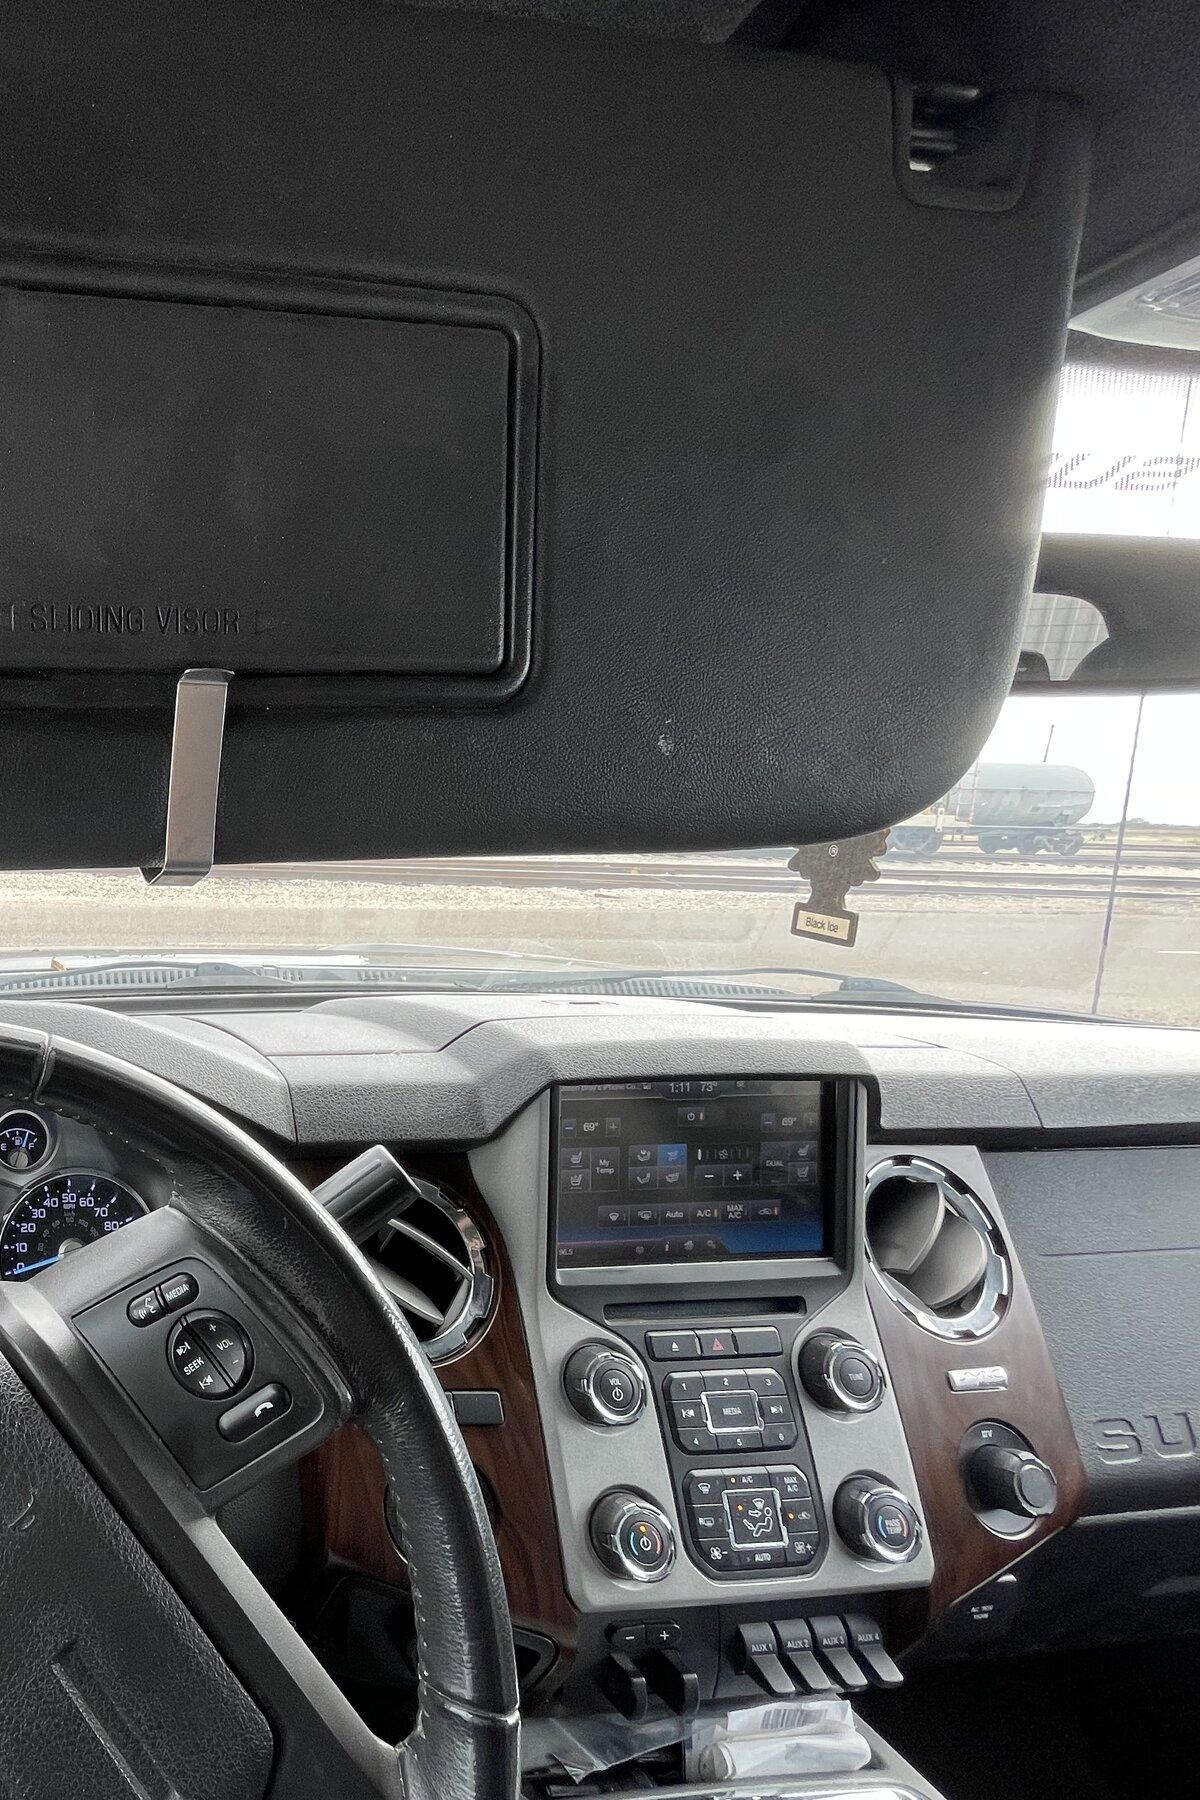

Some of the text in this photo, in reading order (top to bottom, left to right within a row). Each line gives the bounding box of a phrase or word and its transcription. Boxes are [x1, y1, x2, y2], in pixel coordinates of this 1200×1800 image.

[30, 603, 241, 635] SLIDING VISOR
[805, 917, 839, 933] Black Ice
[669, 1082, 691, 1093] 1:11
[599, 1159, 610, 1167] My
[595, 1167, 614, 1175] Temp
[61, 1193, 77, 1203] 50
[79, 1197, 94, 1207] 60
[43, 1198, 59, 1208] 40
[93, 1207, 108, 1217] 70
[727, 1204, 744, 1212] MAX
[31, 1208, 46, 1219] 30
[665, 1210, 684, 1218] Auto
[696, 1209, 712, 1217] A/C
[728, 1211, 742, 1219] A/C
[20, 1223, 36, 1233] 20
[104, 1221, 119, 1231] 80
[15, 1242, 28, 1252] 10
[164, 1283, 190, 1301] MEDIA
[216, 1338, 234, 1351] VOL
[183, 1356, 205, 1376] SEEK
[609, 1378, 622, 1387] VOL
[681, 1382, 687, 1391] 1
[723, 1378, 729, 1386] 2
[765, 1378, 771, 1386] 3
[722, 1407, 742, 1416] MEDIA
[779, 1433, 785, 1441] 6
[693, 1438, 699, 1446] 4
[736, 1438, 743, 1446] 5
[741, 1475, 753, 1483] A/C
[784, 1476, 797, 1484] MAX
[787, 1484, 799, 1492] A/C
[754, 1553, 772, 1562] AUTO
[822, 1636, 845, 1646] AUX 3
[857, 1633, 880, 1642] AUX 4
[751, 1643, 768, 1653] AUX
[786, 1639, 809, 1649] AUX 2
